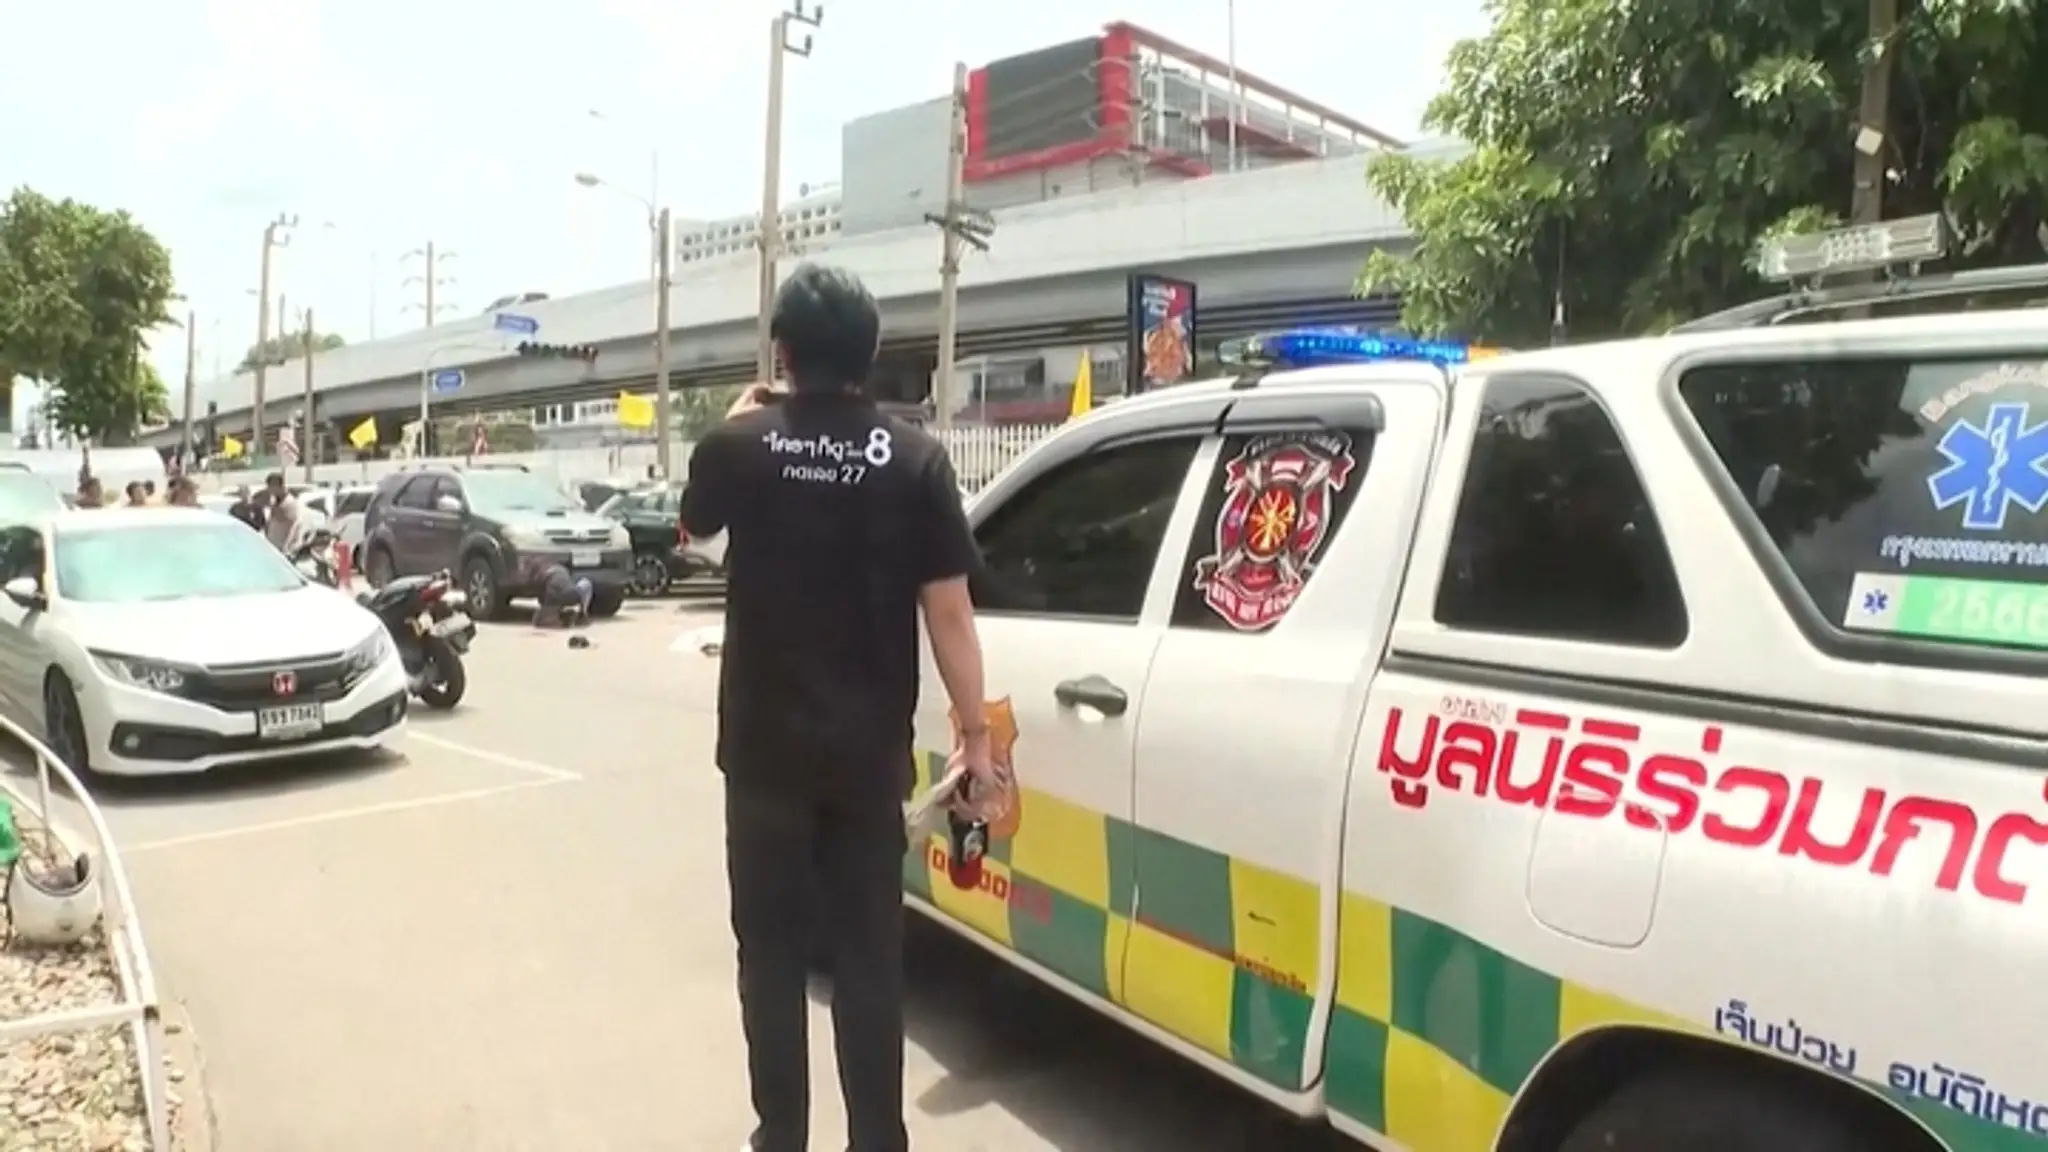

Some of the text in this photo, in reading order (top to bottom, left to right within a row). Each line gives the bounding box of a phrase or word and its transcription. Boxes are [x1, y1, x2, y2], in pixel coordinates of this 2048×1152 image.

[841, 464, 866, 484] 27
[864, 426, 892, 467] 8
[1378, 708, 2048, 904] มูลนิธิร่วมกต
[1714, 998, 1857, 1077] เจ็บป่วย
